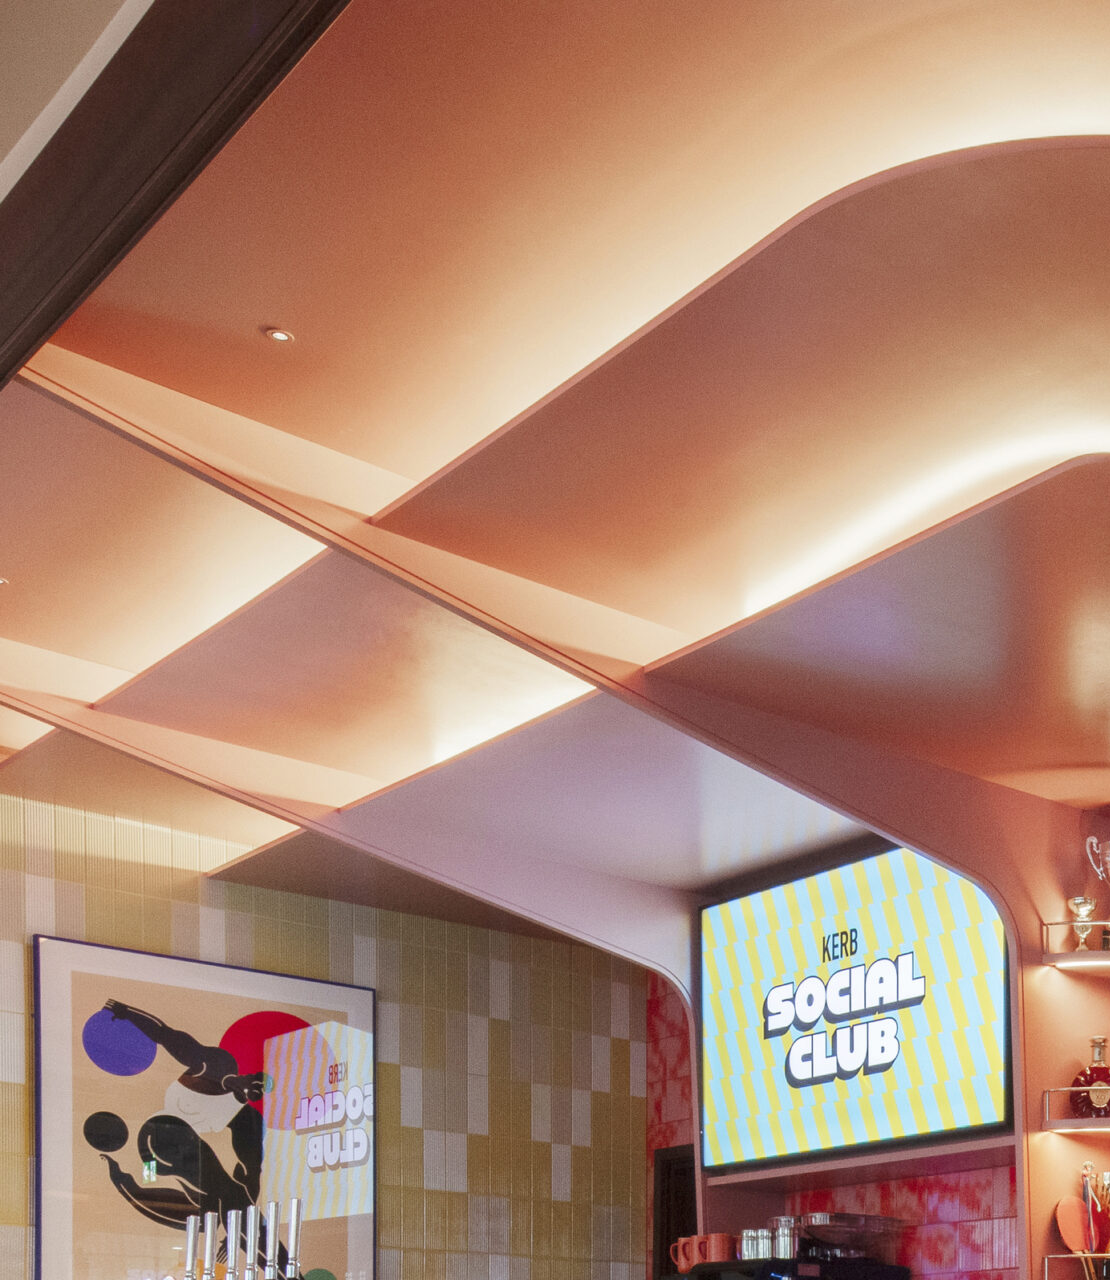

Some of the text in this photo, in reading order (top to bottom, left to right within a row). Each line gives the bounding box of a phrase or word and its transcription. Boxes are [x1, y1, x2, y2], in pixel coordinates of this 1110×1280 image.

[822, 928, 858, 963] KERB
[763, 951, 926, 1040] SOCIAL
[785, 1016, 900, 1089] CLUB
